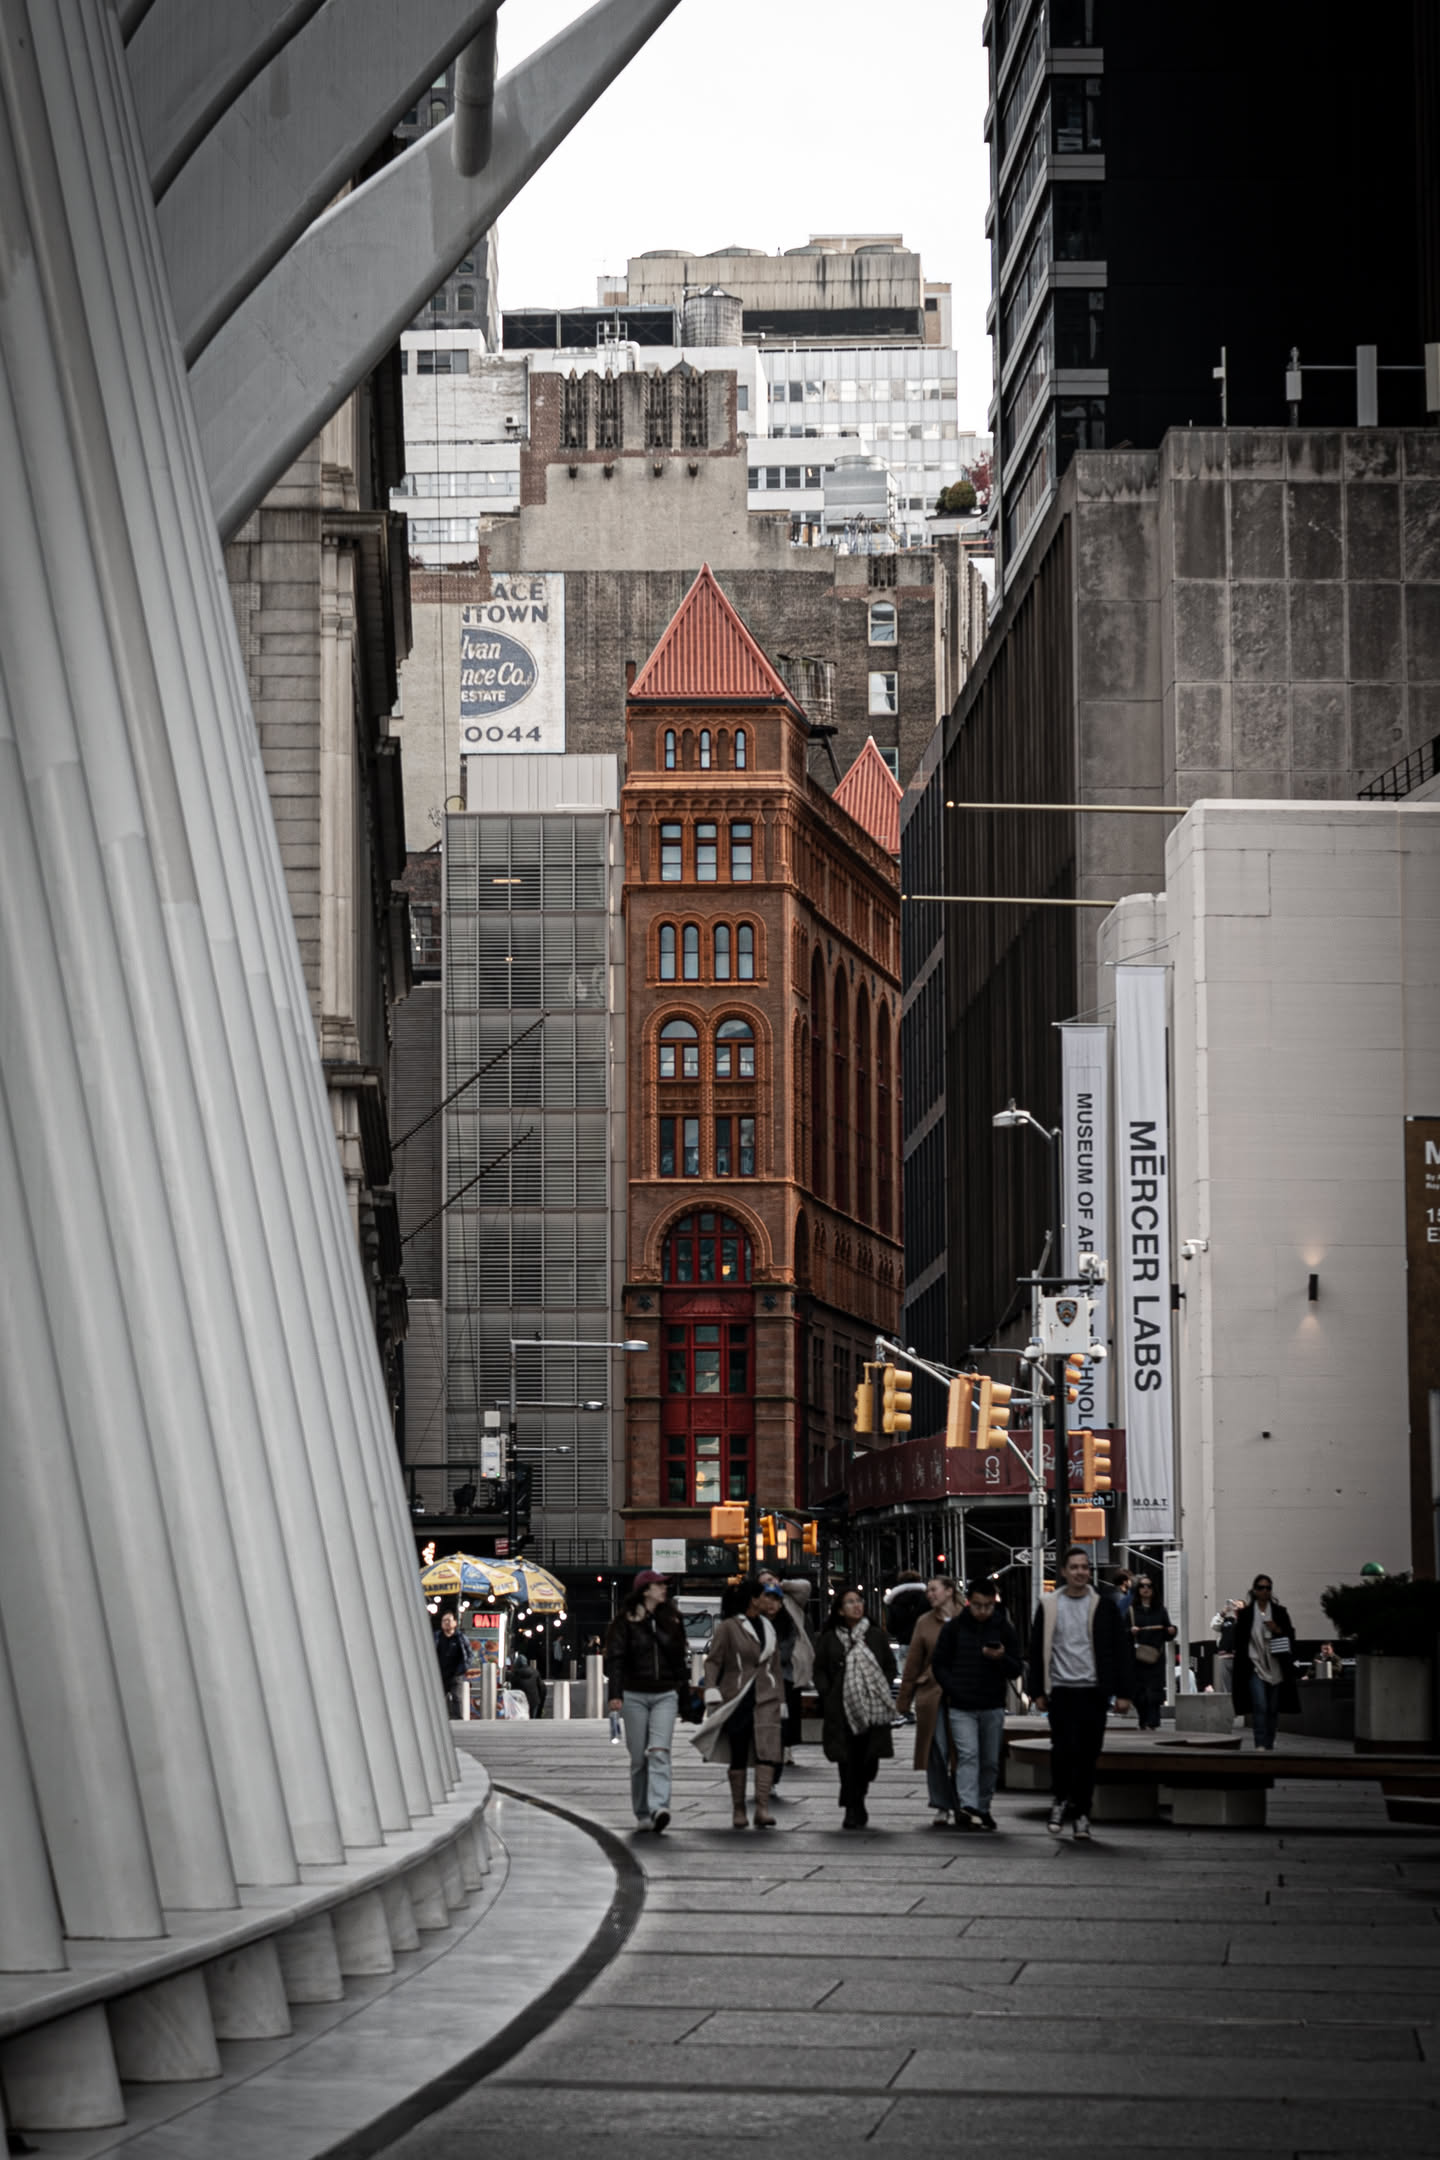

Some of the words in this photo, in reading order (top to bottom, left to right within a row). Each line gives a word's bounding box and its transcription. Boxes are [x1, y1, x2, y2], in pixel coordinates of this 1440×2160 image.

[461, 690, 506, 703] ESTATE
[464, 726, 542, 742] 0044
[1077, 1093, 1094, 1184] MUSEUM
[1077, 1190, 1094, 1220] OF
[1077, 1225, 1094, 1254] AR
[1133, 1296, 1163, 1392] LABS
[984, 1455, 1001, 1485] C21
